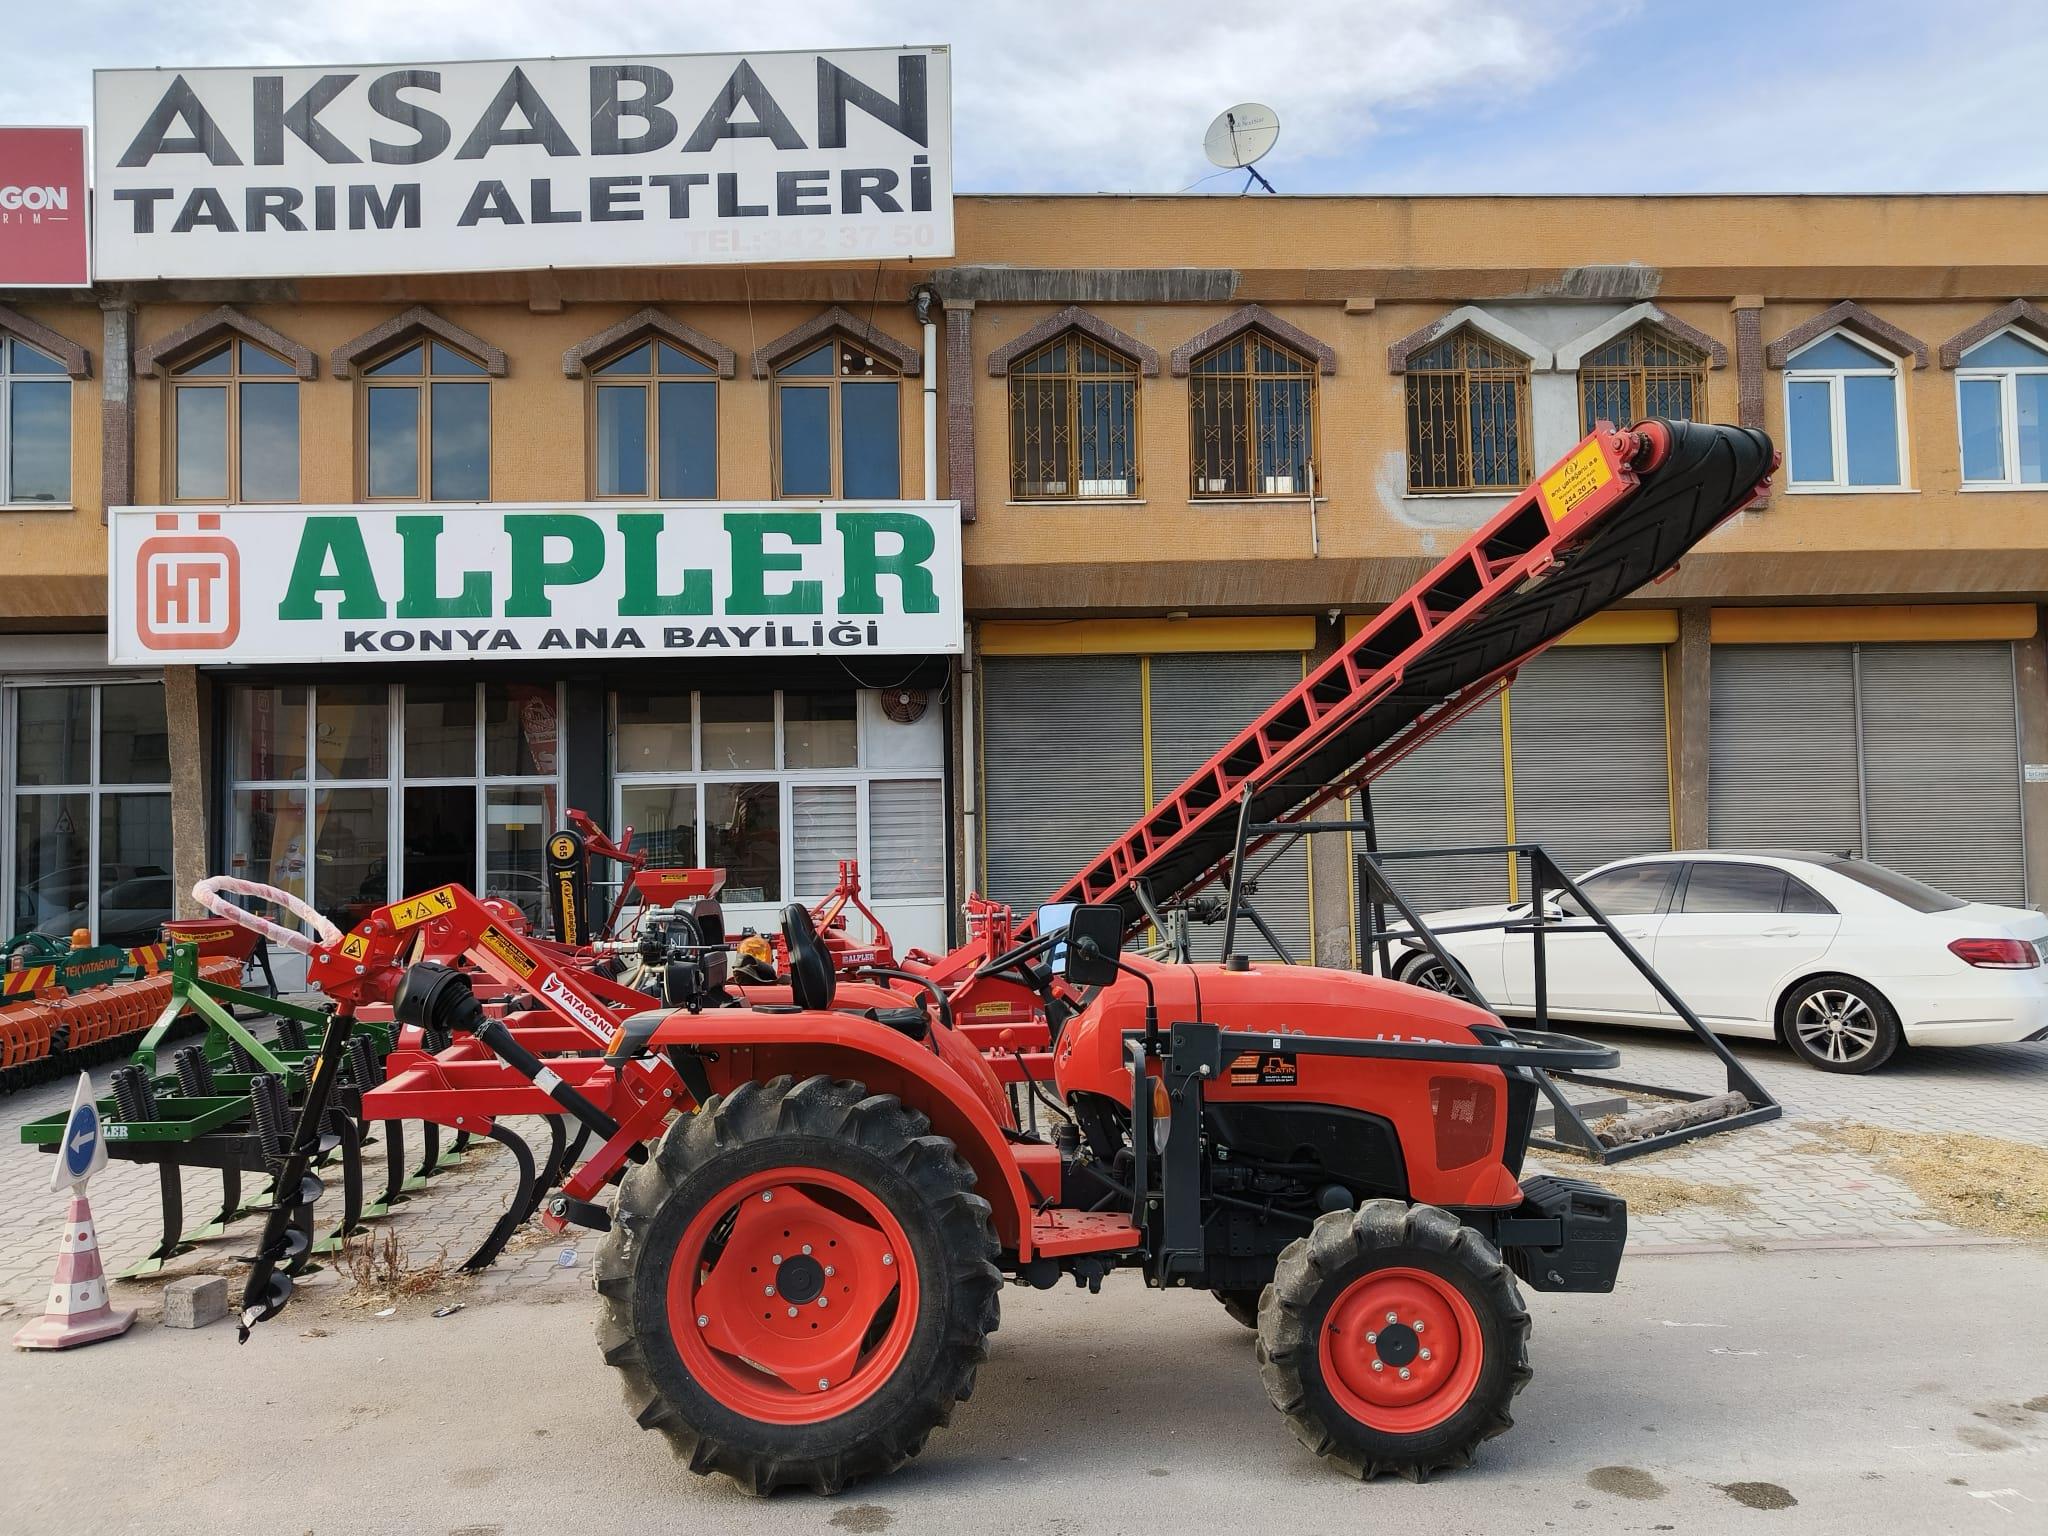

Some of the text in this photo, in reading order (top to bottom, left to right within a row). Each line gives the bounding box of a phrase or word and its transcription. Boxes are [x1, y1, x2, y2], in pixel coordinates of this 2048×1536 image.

[116, 54, 930, 168] AKSABAN
[114, 154, 932, 234] TARIM ALETLERİ
[839, 225, 882, 249] 37
[892, 223, 935, 248] 50
[278, 512, 940, 620] ALPLER
[344, 619, 880, 653] KONYA ANA BAYİLİĞİ
[559, 839, 568, 858] 165
